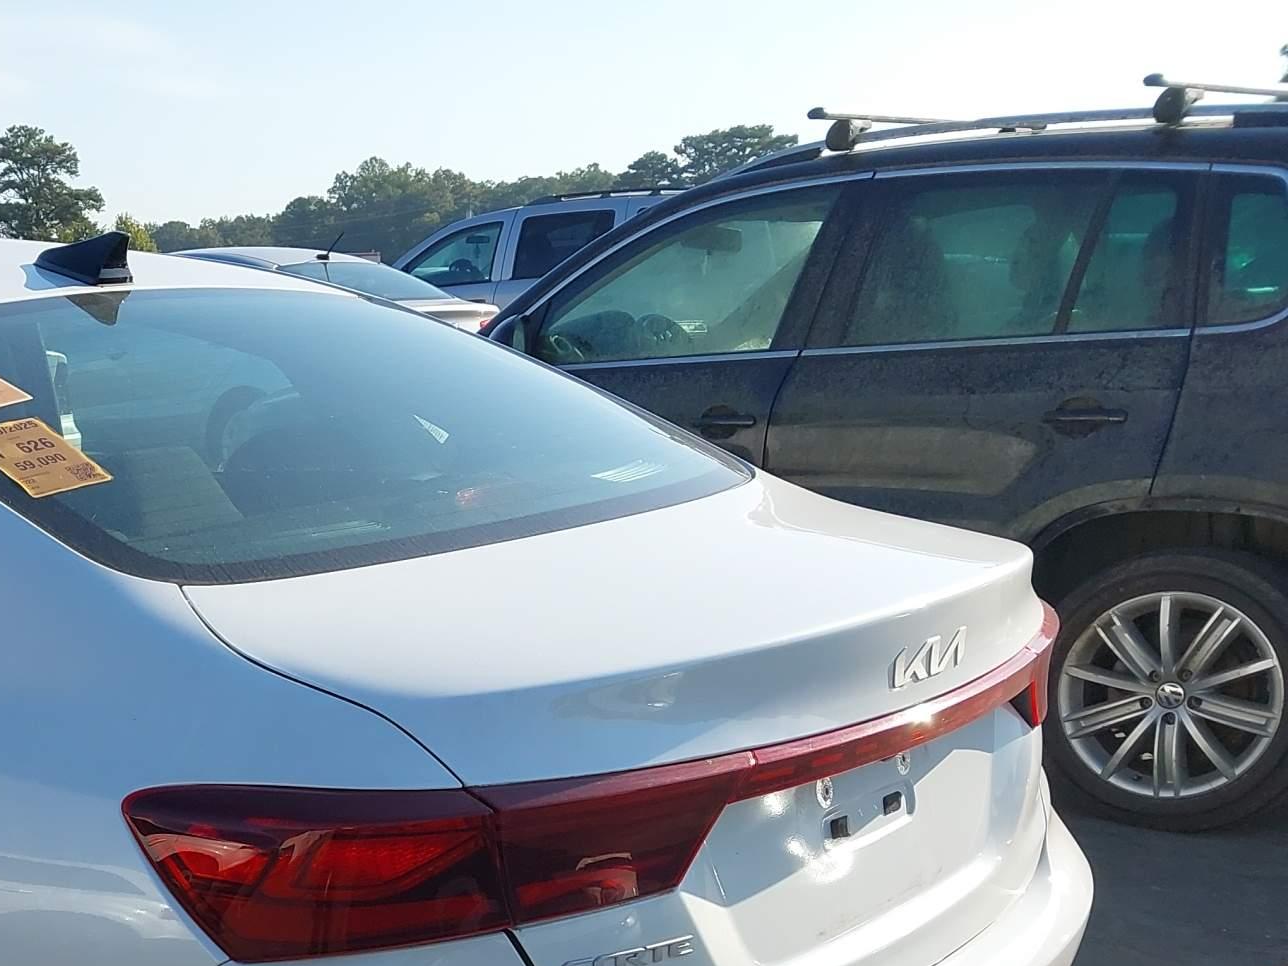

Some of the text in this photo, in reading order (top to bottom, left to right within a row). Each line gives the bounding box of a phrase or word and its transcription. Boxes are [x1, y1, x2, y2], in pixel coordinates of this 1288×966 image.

[15, 436, 56, 454] 626
[14, 453, 67, 471] 59,090
[888, 625, 967, 690] KIA
